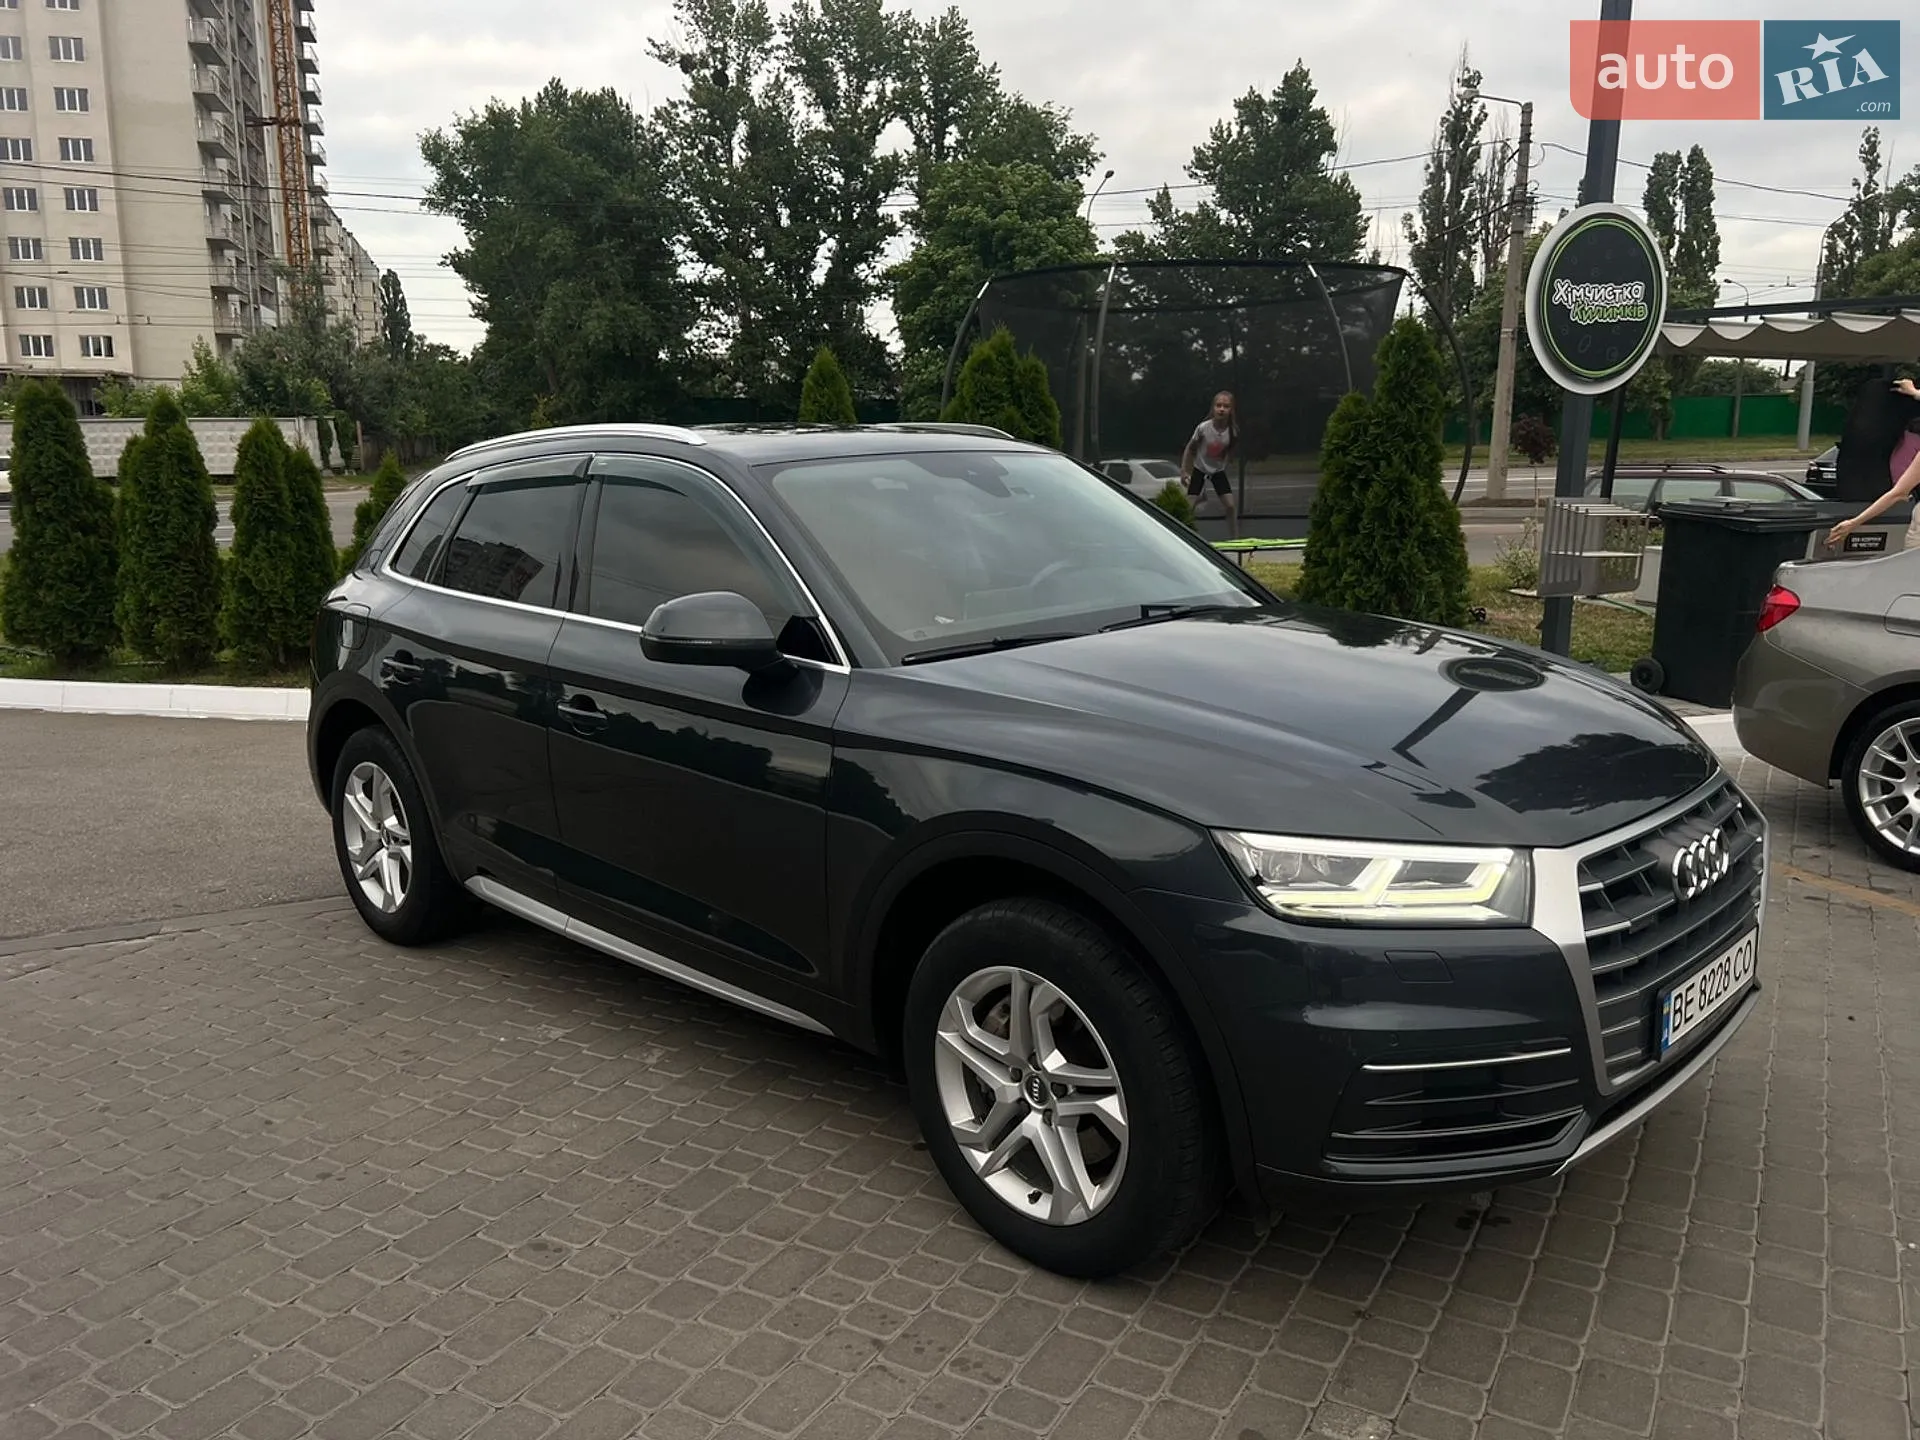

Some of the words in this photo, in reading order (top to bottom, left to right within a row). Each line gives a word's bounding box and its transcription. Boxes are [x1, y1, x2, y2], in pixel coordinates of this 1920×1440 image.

[1553, 280, 1644, 308] Хімчистка
[1572, 300, 1647, 323] Килимків
[1672, 982, 1696, 1033] BE
[1698, 956, 1731, 1012] 8228
[1733, 939, 1752, 982] CO
